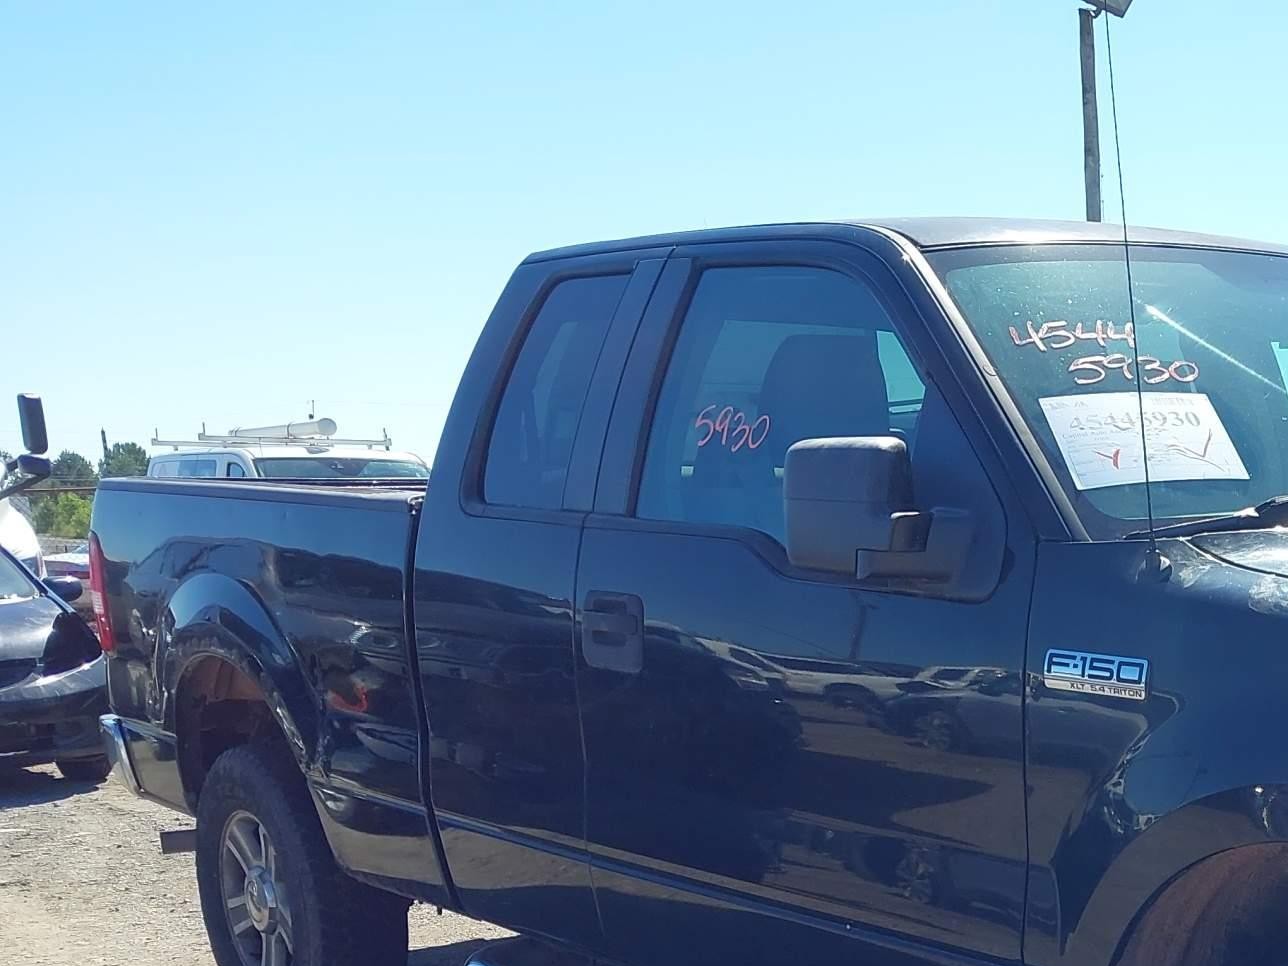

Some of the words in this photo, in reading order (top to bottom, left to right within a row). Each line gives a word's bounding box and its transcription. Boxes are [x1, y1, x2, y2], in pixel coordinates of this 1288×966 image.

[1008, 320, 1136, 351] 4544
[1068, 354, 1199, 385] 5930
[695, 404, 770, 453] 5930
[1070, 410, 1201, 431] 45445930
[1046, 653, 1145, 684] F-150
[1070, 681, 1086, 690] XLT
[1108, 687, 1144, 698] TRITON
